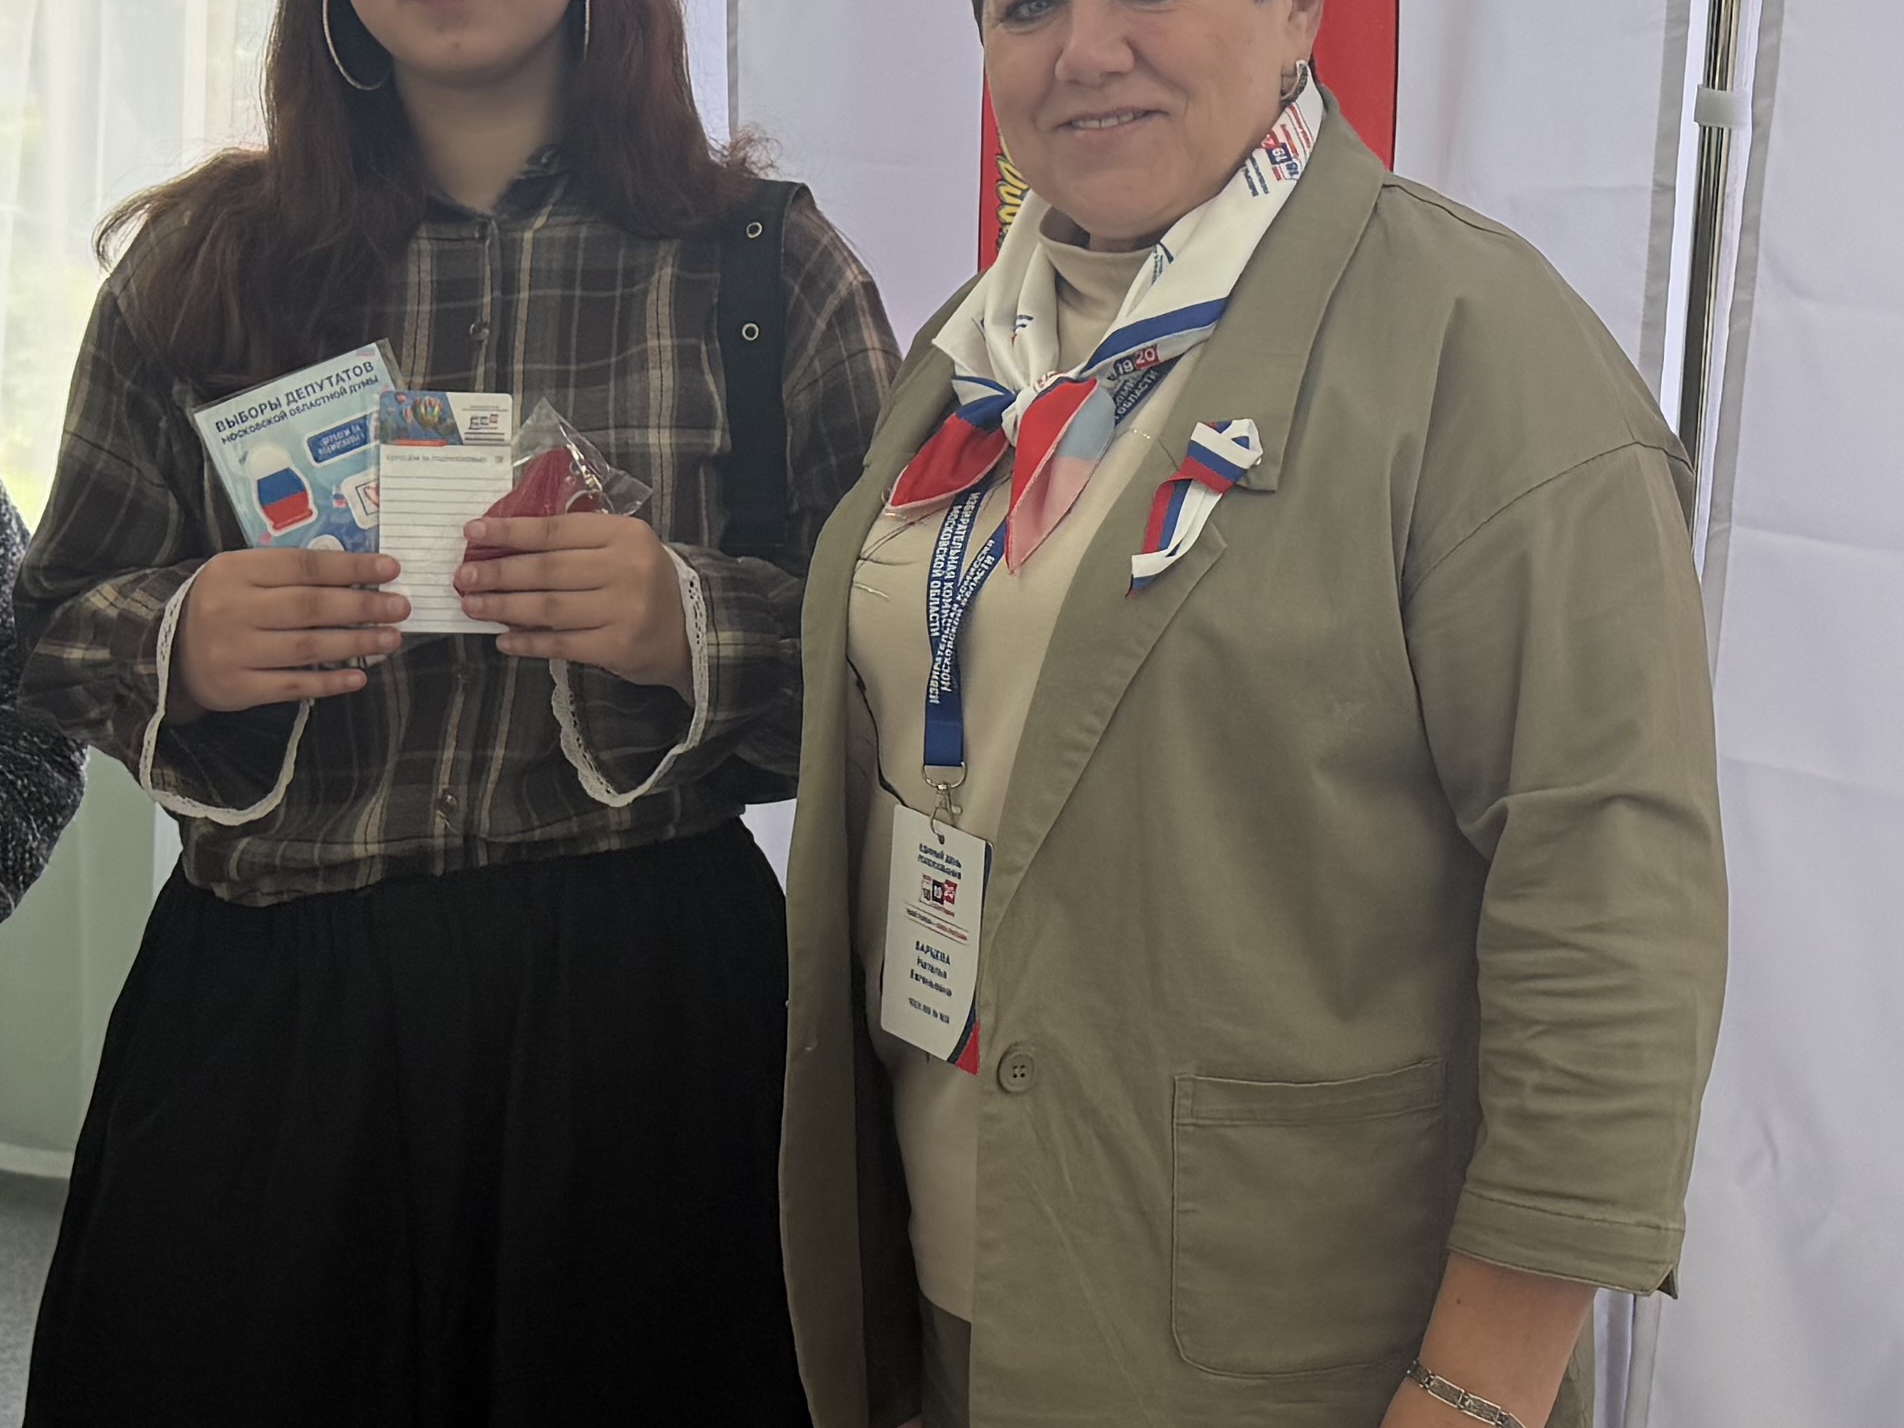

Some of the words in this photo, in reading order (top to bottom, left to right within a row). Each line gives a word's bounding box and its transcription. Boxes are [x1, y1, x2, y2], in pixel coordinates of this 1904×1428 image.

[1117, 358, 1134, 375] 19
[1135, 347, 1157, 365] 20
[215, 397, 283, 433] ВЫБОРЫ
[285, 361, 375, 406] ДЕПУТАТОВ
[290, 385, 348, 417] ОБЛАСТНОЙ
[932, 505, 963, 579] МОСКОВСКОЙ
[945, 491, 981, 579] ИЗБИРАТЕЛЬНАЯ
[929, 581, 942, 637] ОБЛАСТИ
